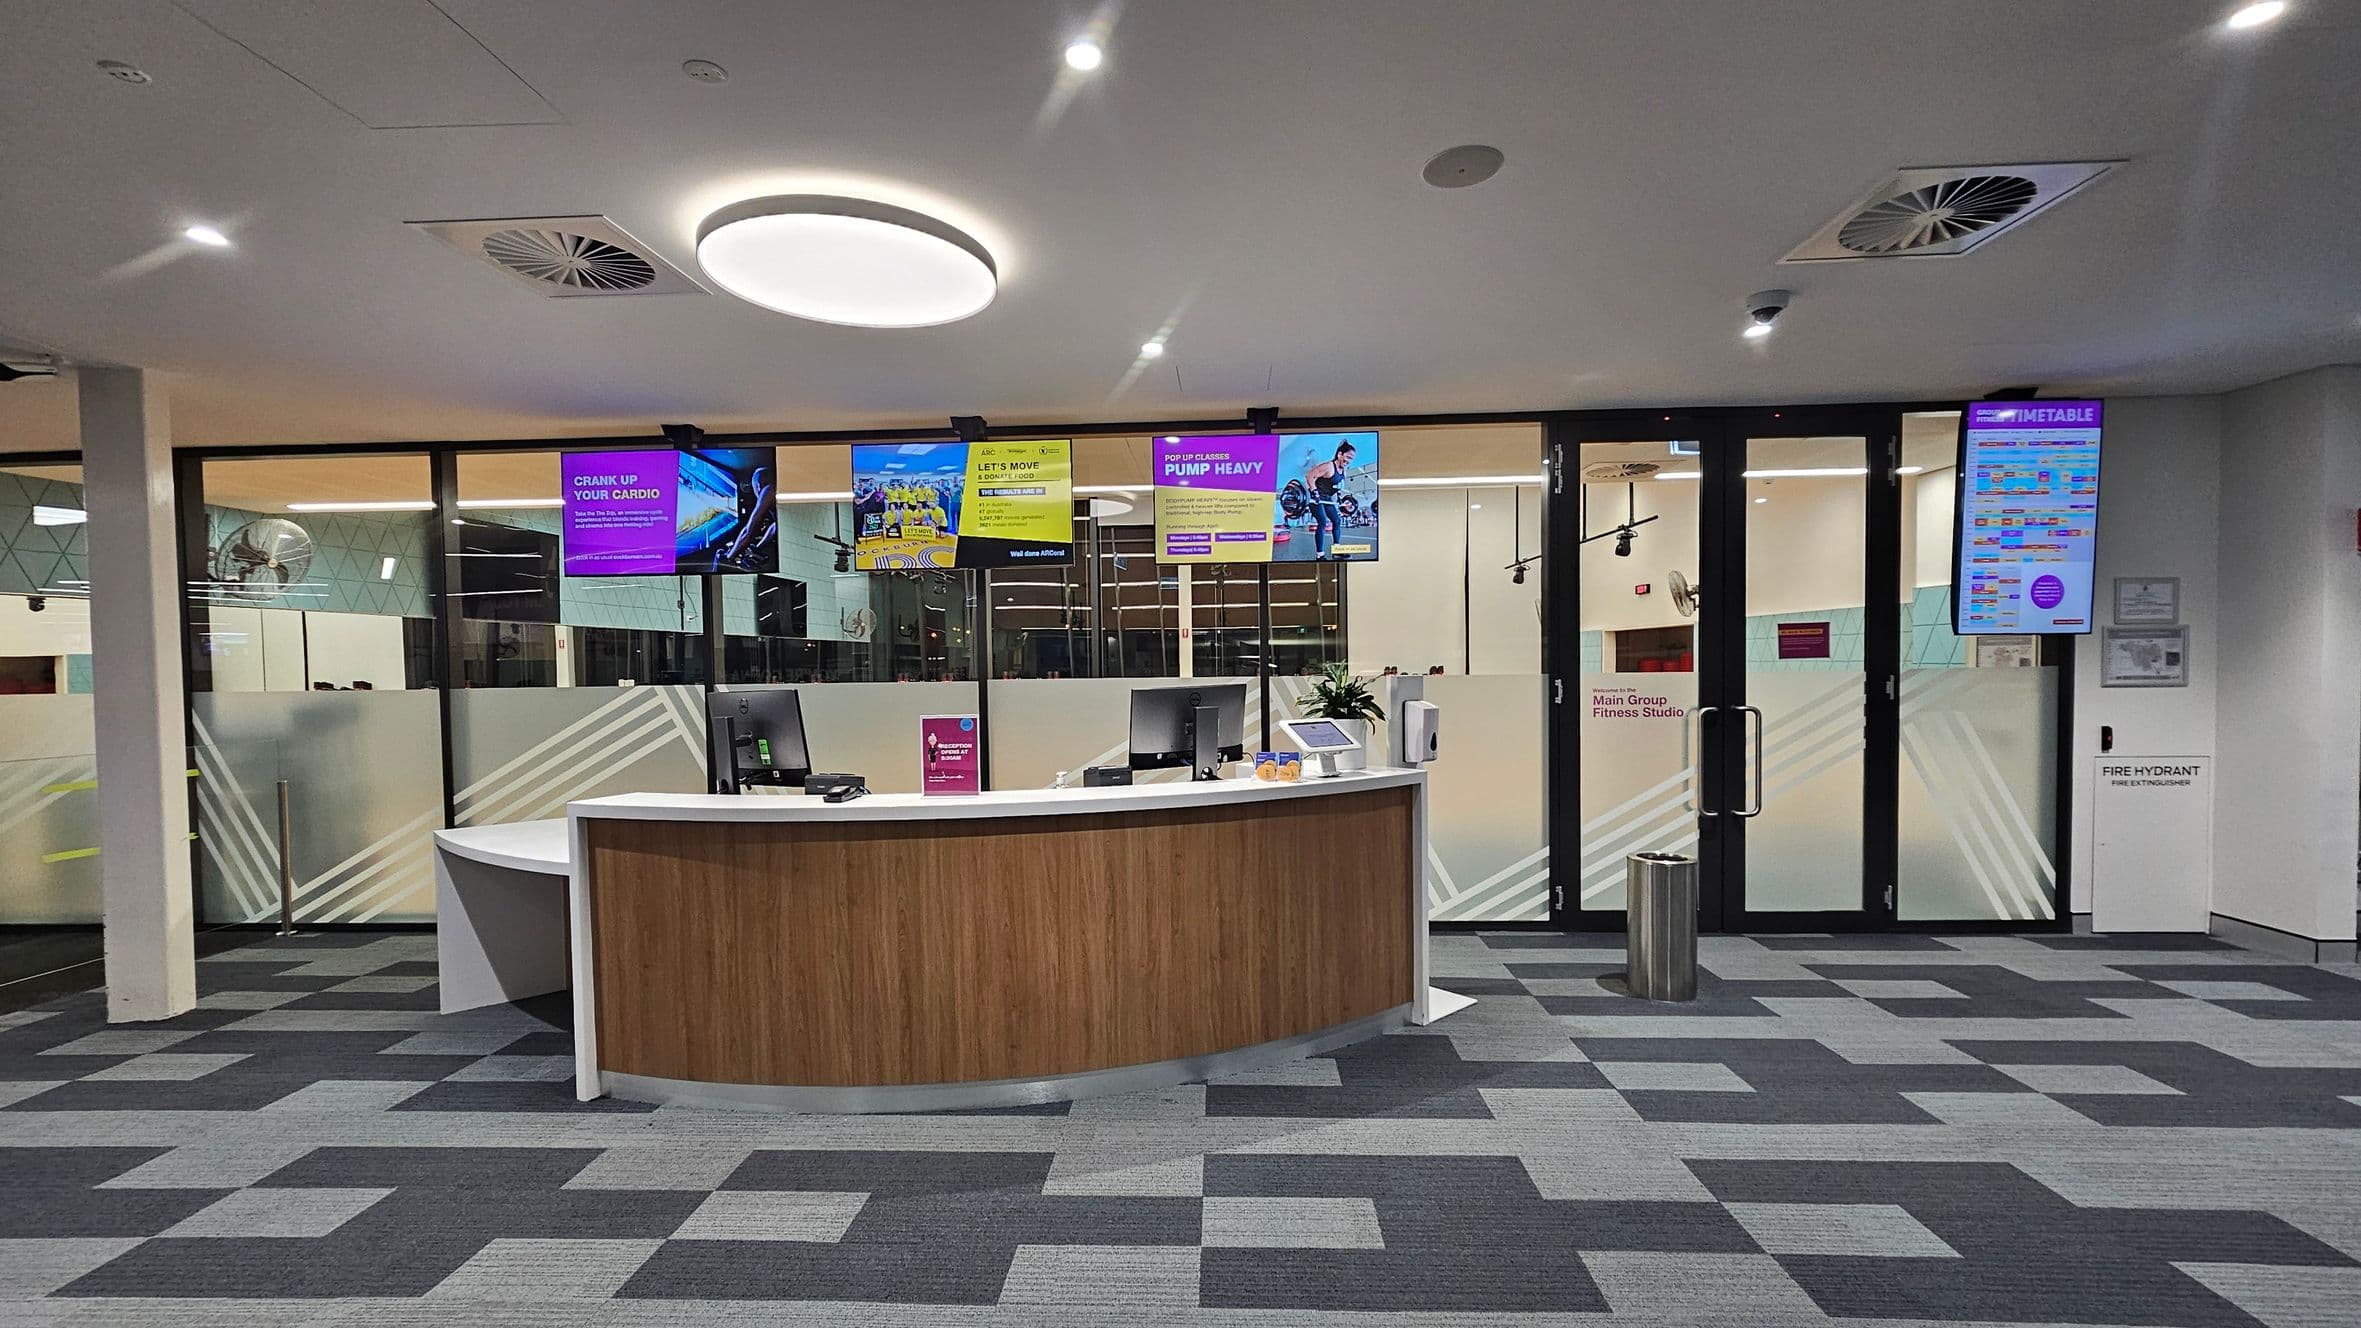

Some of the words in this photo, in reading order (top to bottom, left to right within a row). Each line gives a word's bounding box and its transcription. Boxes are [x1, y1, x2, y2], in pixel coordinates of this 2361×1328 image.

[2008, 408, 2093, 422] TIMETABLE
[978, 463, 1006, 471] LET'S
[1010, 462, 1039, 470] MOVE
[1165, 463, 1210, 476] PUMP
[1215, 462, 1263, 475] HEAVY
[574, 475, 617, 486] CRANK
[621, 475, 638, 485] UP
[574, 490, 608, 500] YOUR
[612, 489, 660, 499] CARDIO
[1593, 695, 1623, 705] Main
[1628, 695, 1667, 707] Group
[1593, 708, 1639, 717] Fitness
[1643, 707, 1684, 717] Studio
[2103, 766, 2131, 776] FIRE
[2135, 766, 2201, 776] HYDRANT
